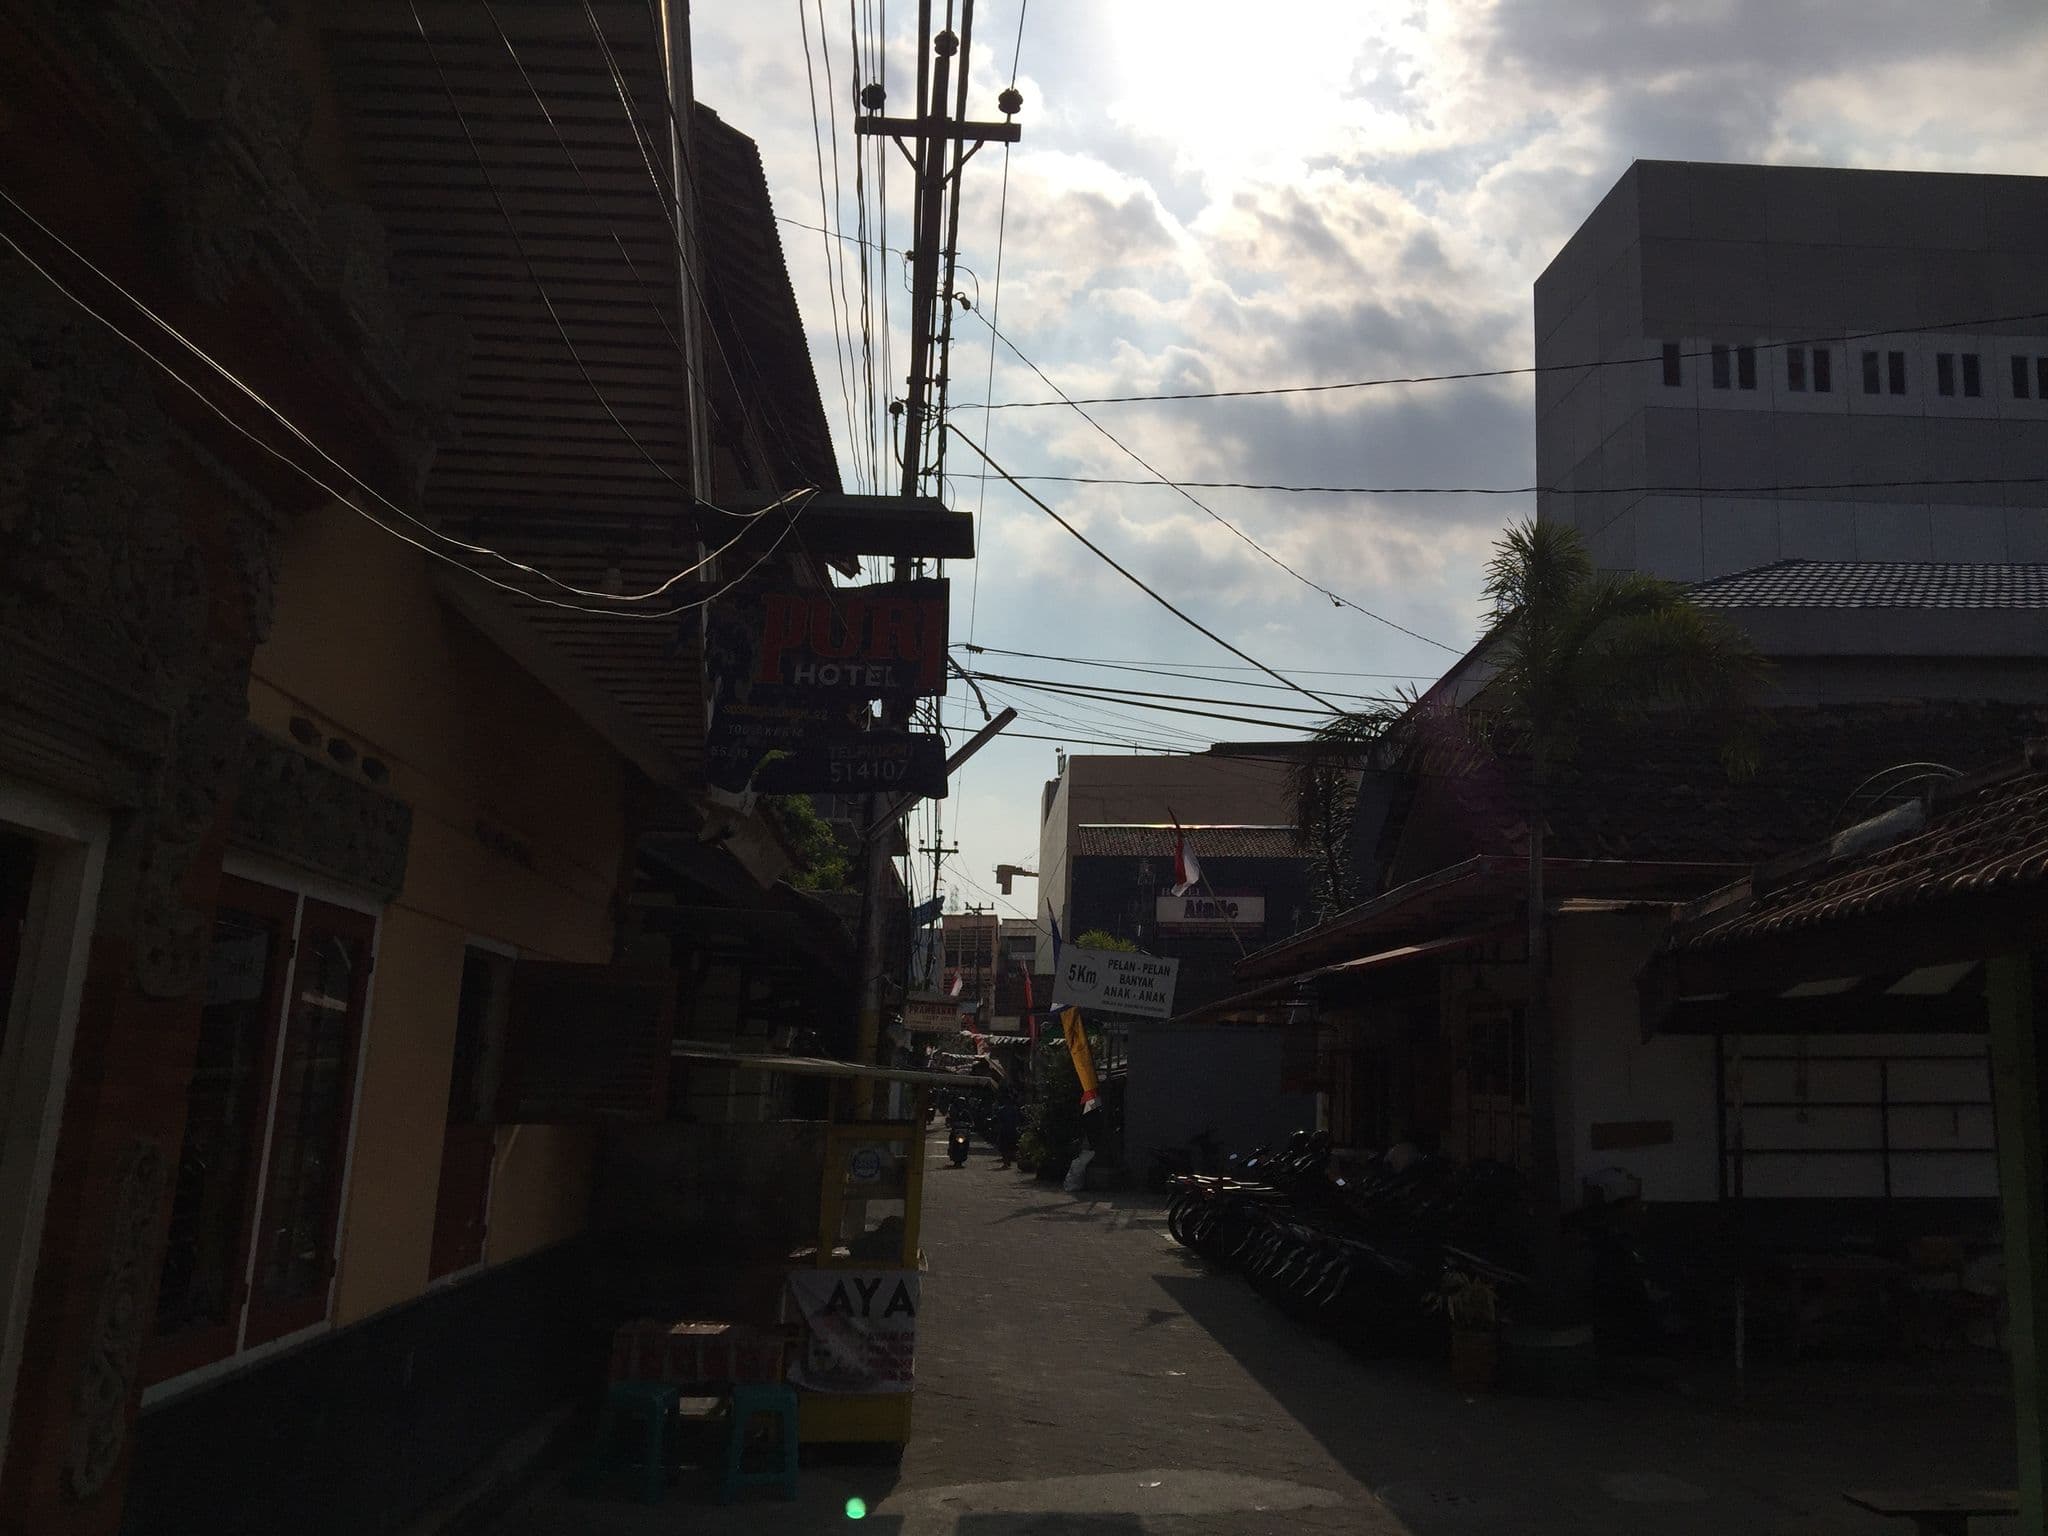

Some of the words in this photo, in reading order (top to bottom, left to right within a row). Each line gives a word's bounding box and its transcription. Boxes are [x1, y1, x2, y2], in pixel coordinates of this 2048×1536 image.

[754, 593, 942, 690] PURI
[793, 664, 897, 688] HOTEL
[829, 759, 908, 783] 514107
[1107, 959, 1136, 972] PELAN
[1142, 963, 1171, 976] PELAN
[1119, 973, 1154, 988] BANYAK
[1103, 985, 1130, 999] ANAK
[1138, 990, 1166, 1003] ANAK
